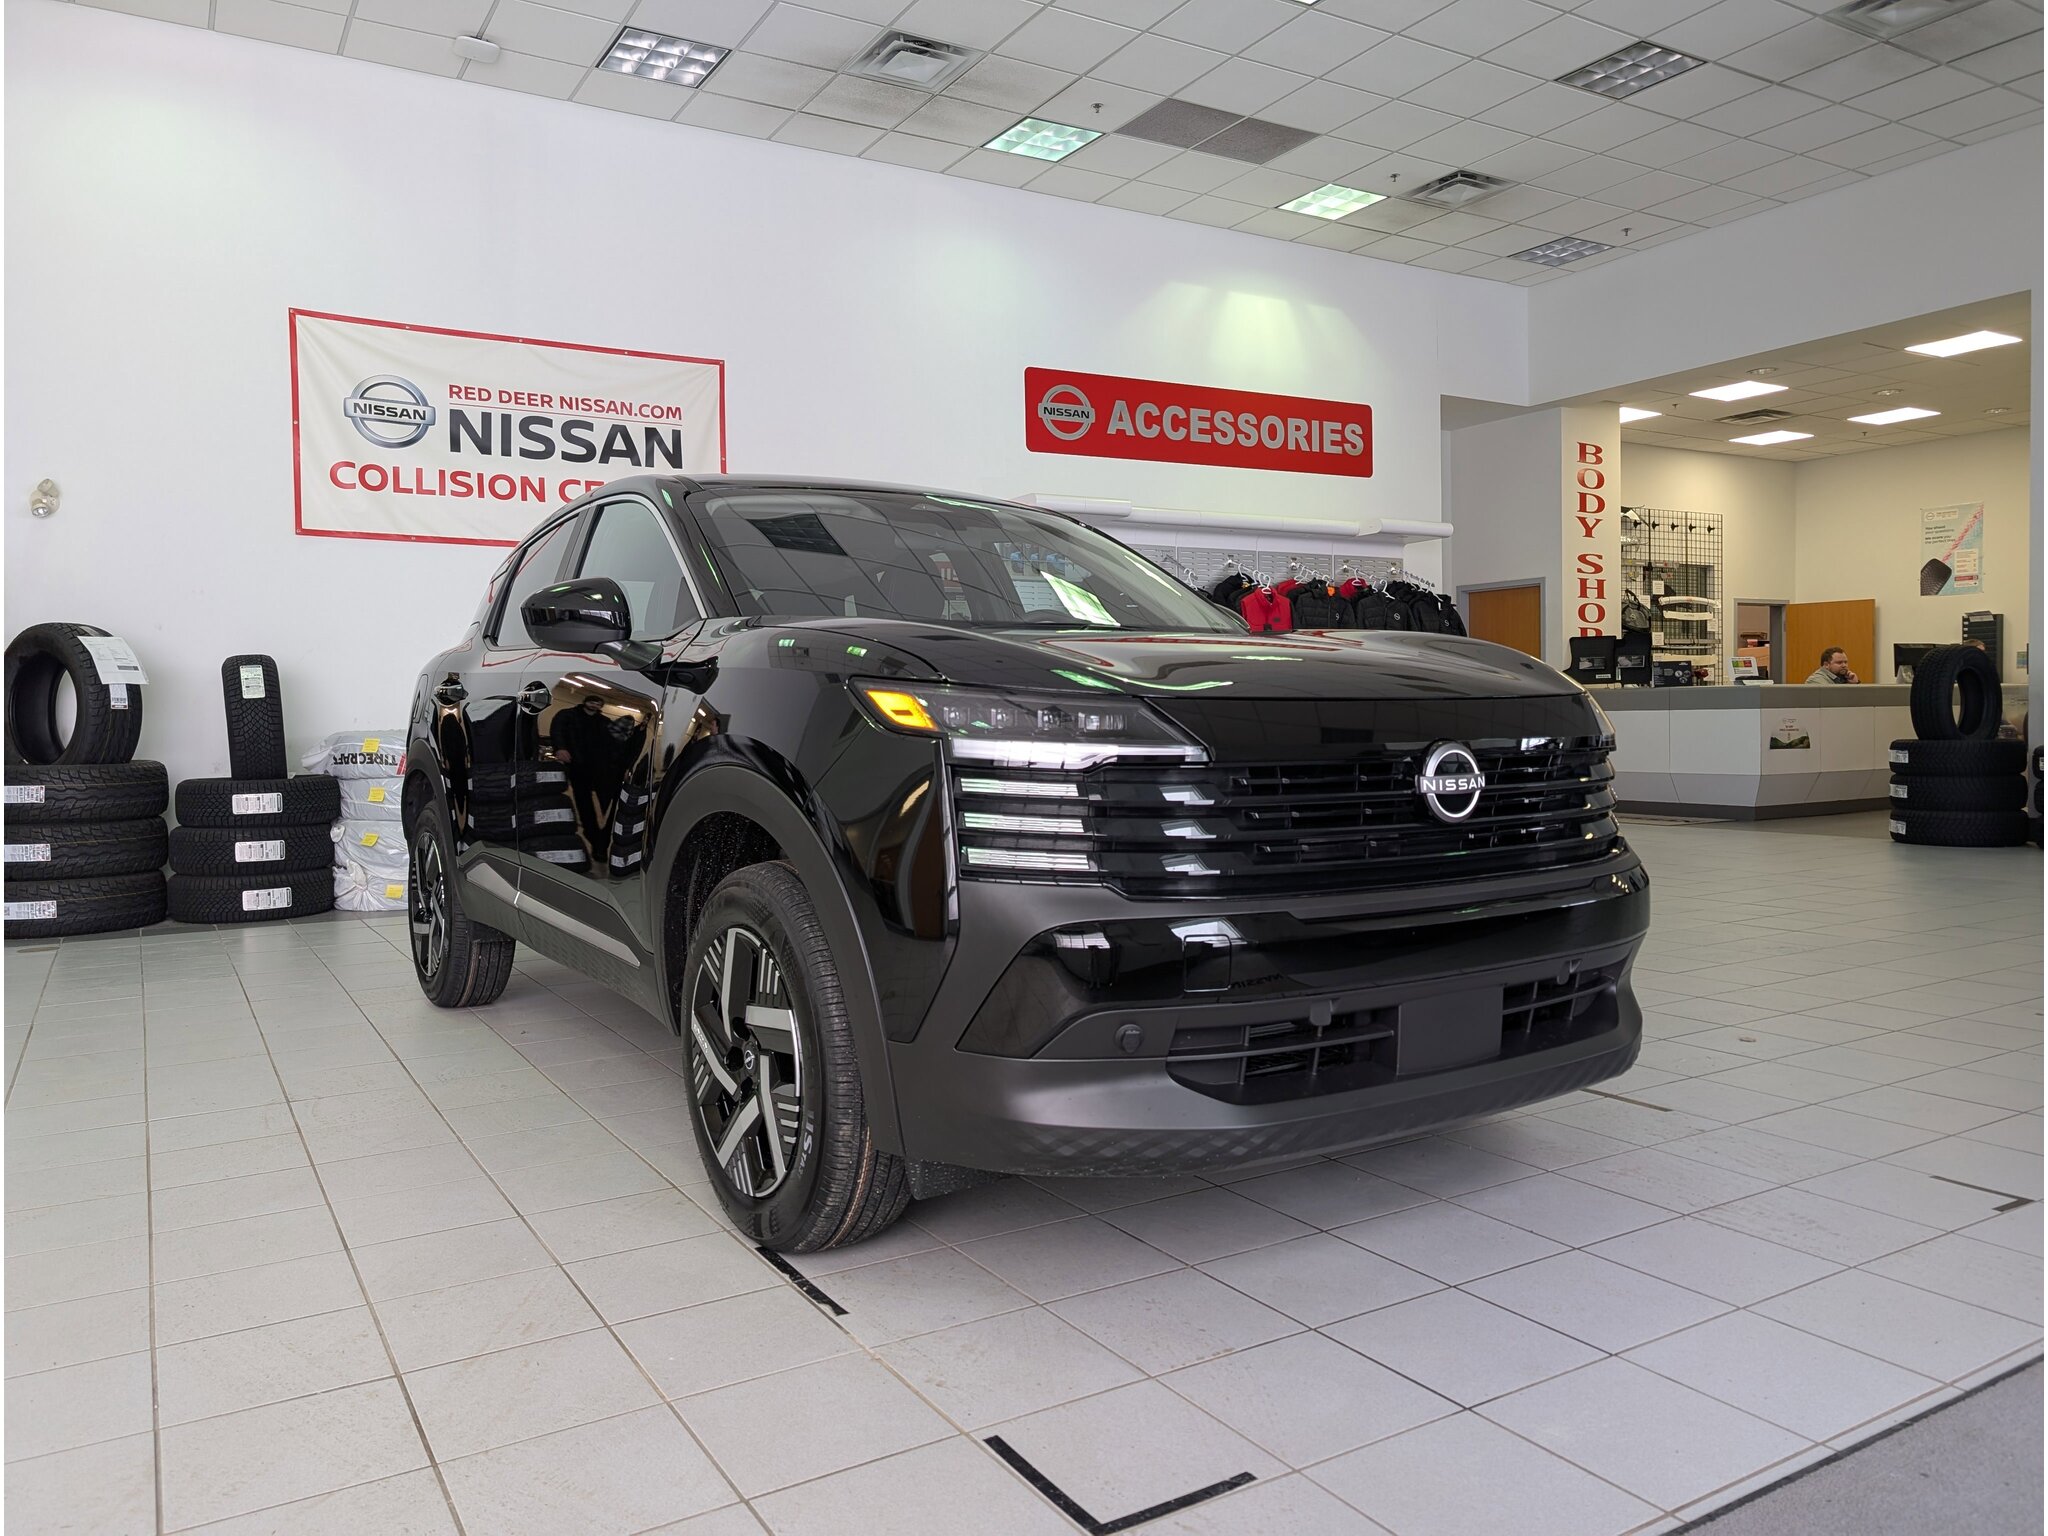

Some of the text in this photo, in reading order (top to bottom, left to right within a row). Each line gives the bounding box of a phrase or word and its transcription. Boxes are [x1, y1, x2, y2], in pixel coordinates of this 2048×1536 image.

[353, 402, 427, 421] NISSAN
[448, 384, 683, 421] RED DEER NISSAN.COM
[1043, 406, 1090, 419] NISSAN
[449, 409, 683, 469] NISSAN
[1107, 399, 1364, 456] ACCESSORIES
[329, 460, 546, 503] COLLISION
[1576, 441, 1606, 538] BODY
[1422, 775, 1486, 791] NISSAN
